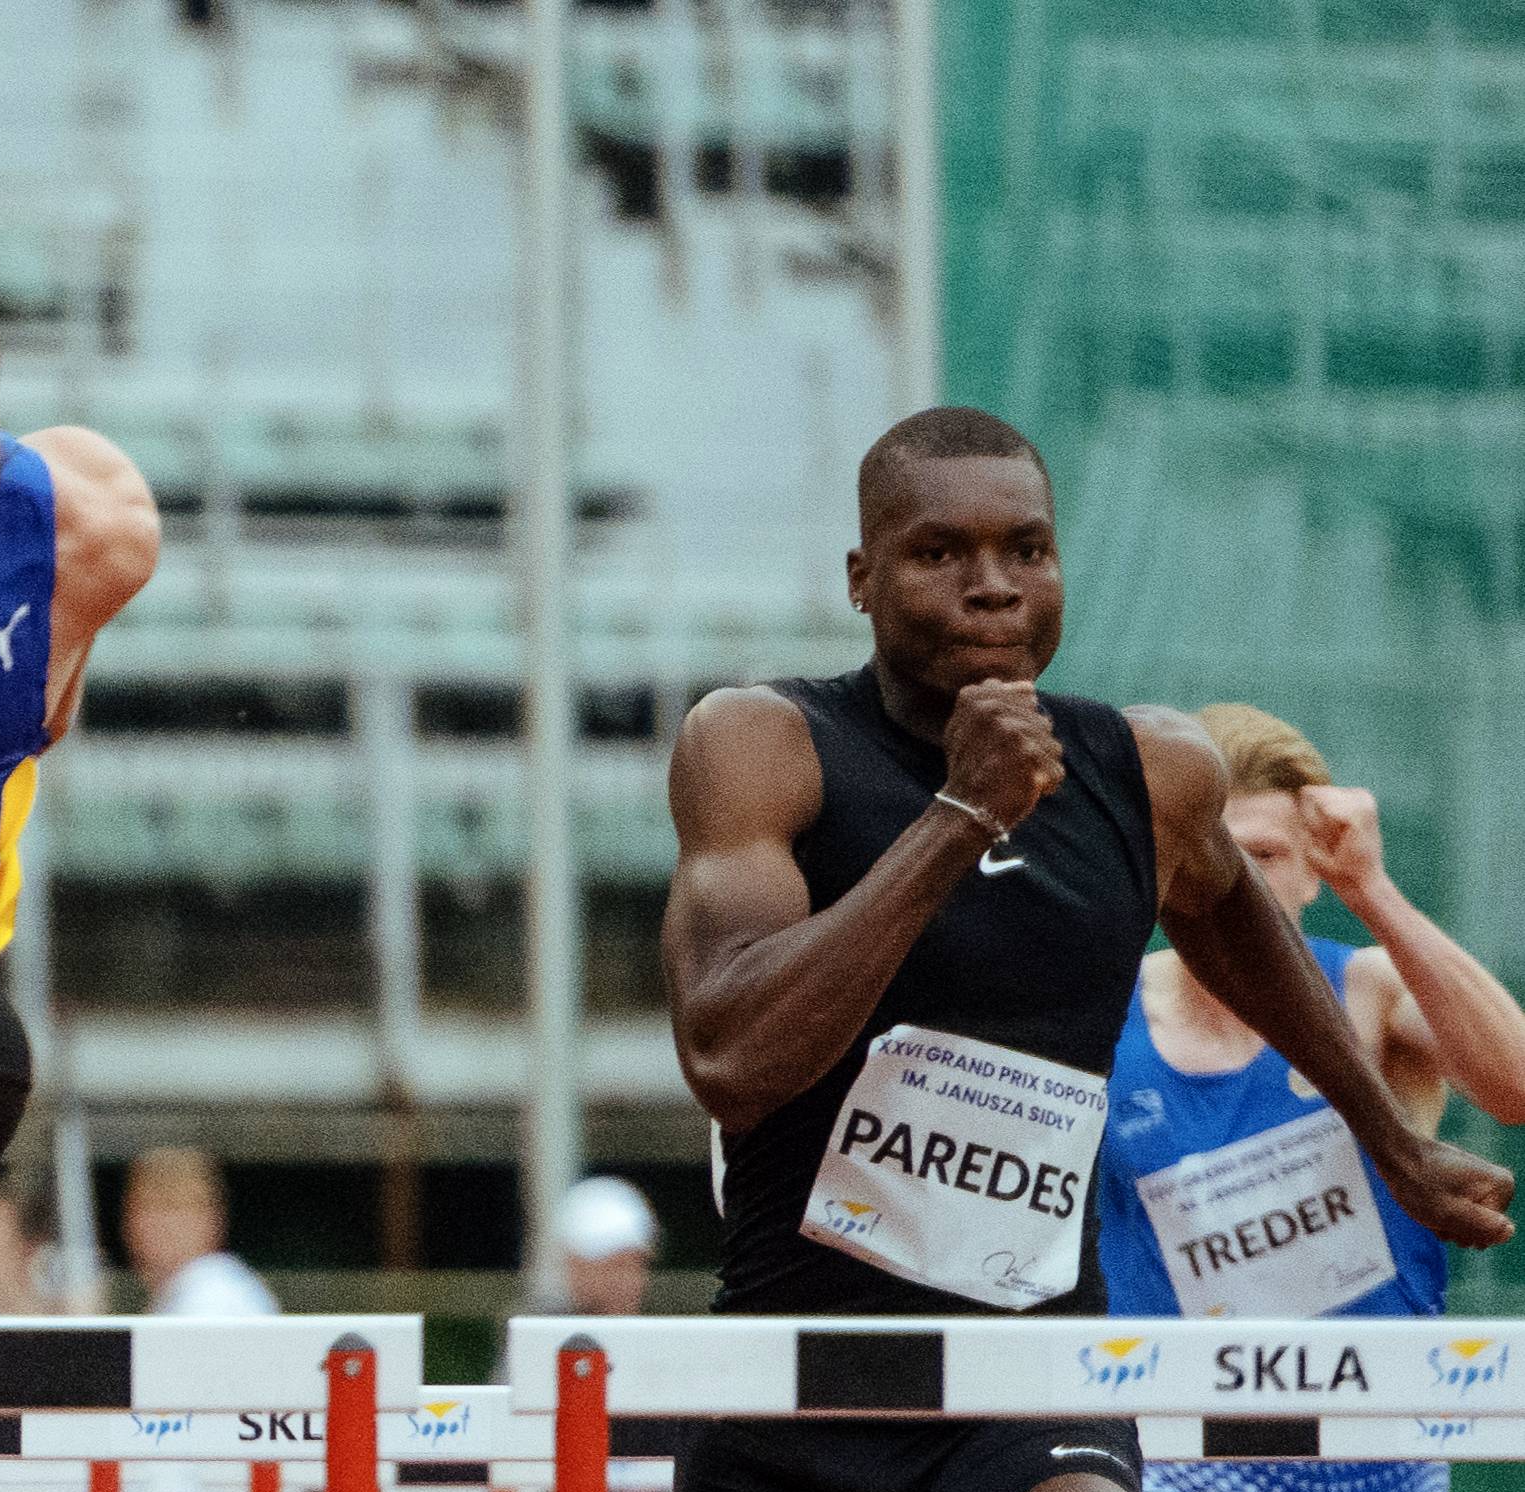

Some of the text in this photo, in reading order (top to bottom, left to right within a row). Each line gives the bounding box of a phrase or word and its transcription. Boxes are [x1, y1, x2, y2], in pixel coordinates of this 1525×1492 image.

[878, 1037, 1106, 1111] XXVI GRAND PRIX SOPOTU
[900, 1068, 1075, 1132] IM. JANUSZA SIDŁY
[839, 1108, 1079, 1220] PAREDES
[1177, 1185, 1356, 1279] TREDER
[1077, 1343, 1510, 1397] Sopot SKLA Sopot
[238, 1412, 324, 1441] SKL
